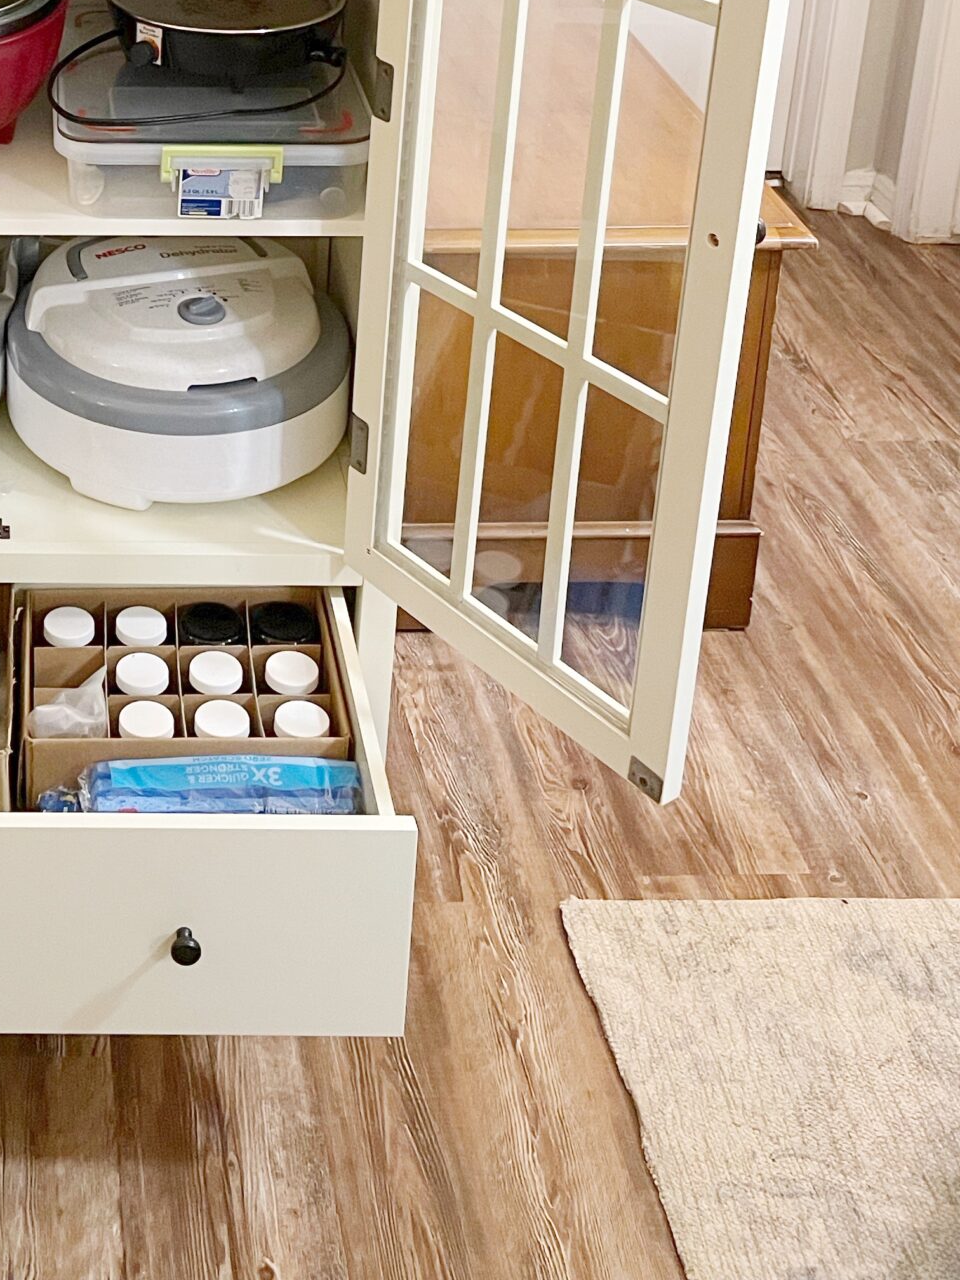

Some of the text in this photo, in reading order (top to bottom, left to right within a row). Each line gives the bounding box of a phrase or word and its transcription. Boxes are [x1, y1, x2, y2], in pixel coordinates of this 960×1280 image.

[95, 243, 147, 260] NESCO
[159, 247, 239, 259] Dehydrator
[186, 762, 248, 773] STRONGER
[196, 772, 250, 784] QUICKER
[252, 767, 284, 786] 3X
